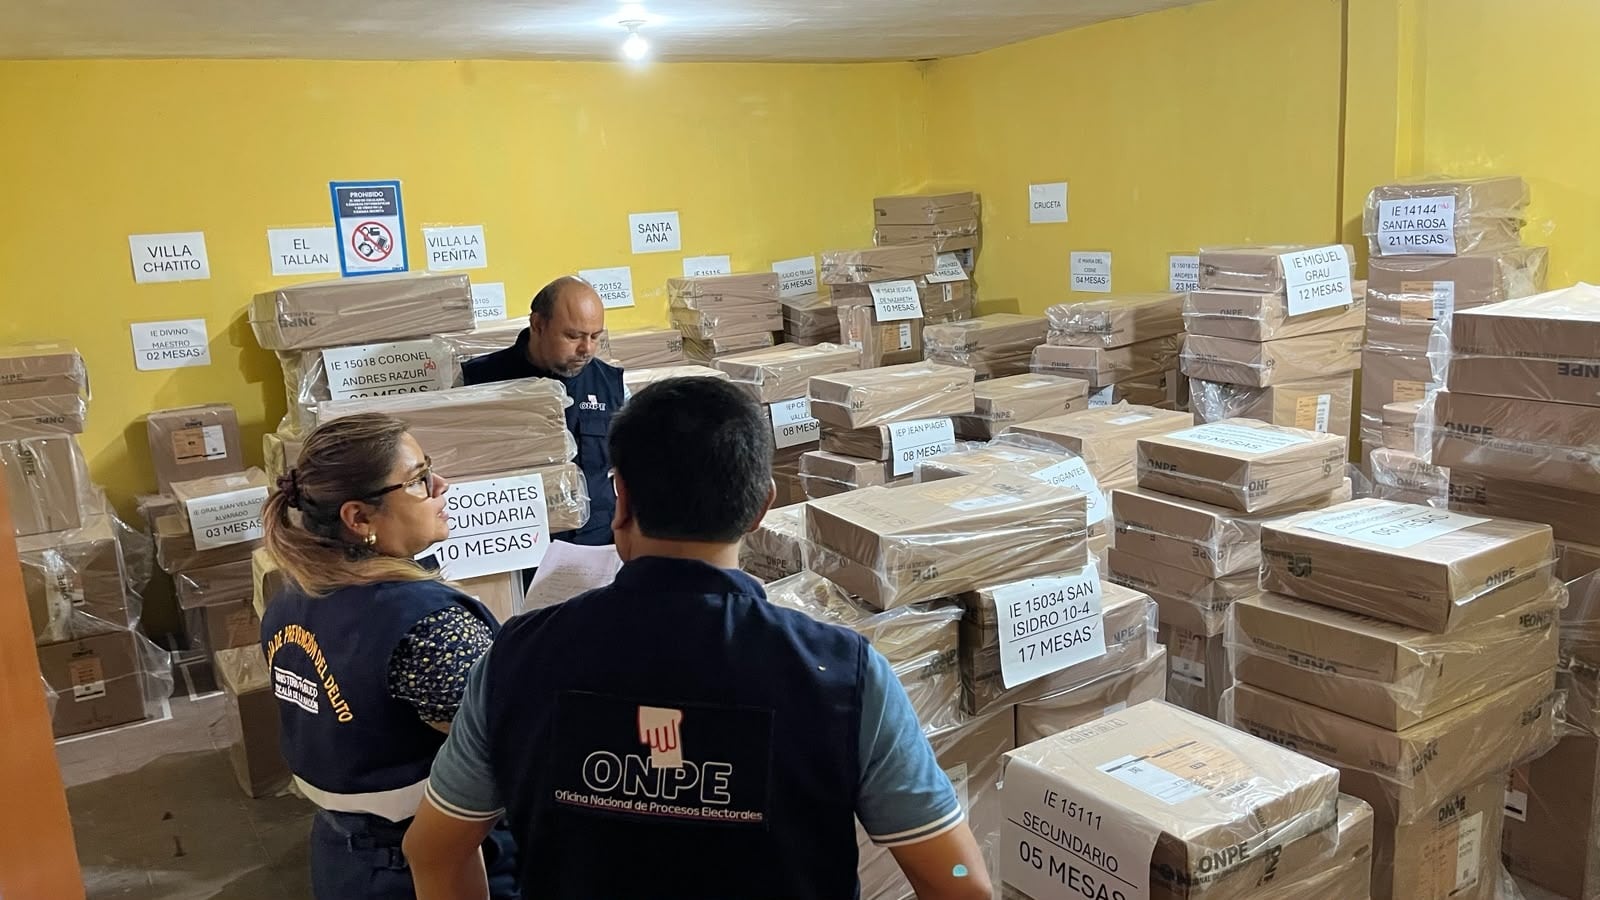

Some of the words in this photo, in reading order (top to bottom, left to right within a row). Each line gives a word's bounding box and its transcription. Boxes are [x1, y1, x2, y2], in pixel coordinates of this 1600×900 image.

[1034, 200, 1061, 209] CRUCETA
[1392, 206, 1400, 216] IE
[1404, 204, 1437, 215] 14144
[638, 222, 672, 234] SANTA
[1382, 219, 1415, 230] SANTA
[1416, 218, 1446, 229] ROSA
[294, 238, 310, 250] EL
[428, 236, 461, 248] VILLA
[464, 234, 478, 246] LA
[646, 233, 668, 244] ANA
[1388, 236, 1400, 246] 21
[1404, 234, 1444, 245] MESAS
[147, 244, 192, 258] VILLA
[433, 248, 477, 262] PEÑITA
[143, 259, 201, 273] CHATITO
[281, 254, 329, 266] TALLAN
[1292, 258, 1302, 268] IE
[1304, 250, 1342, 266] MIGUEL
[1084, 276, 1106, 284] MESAS
[1304, 268, 1330, 282] GRAU
[599, 282, 622, 290] 20152
[790, 278, 812, 288] MESAS
[1176, 282, 1184, 290] 23
[600, 292, 626, 300] MESAS
[1298, 290, 1310, 300] 12
[1312, 282, 1343, 298] MESAS
[892, 304, 915, 312] MESAS
[160, 328, 188, 336] DIVINO
[152, 340, 190, 348] MAESTRO
[146, 352, 160, 361] 02
[162, 348, 200, 359] MESAS
[331, 362, 342, 370] IE
[344, 356, 376, 369] 15018
[378, 352, 431, 365] CORONEL
[342, 373, 387, 386] ANDRES
[389, 369, 427, 380] RAZURI
[1558, 362, 1600, 378] NPE
[580, 402, 606, 410] ONPE
[783, 426, 794, 436] 08
[796, 421, 820, 433] MESA
[896, 428, 906, 437] IEP
[908, 425, 924, 435] JEAN
[925, 420, 948, 430] PIAGET
[904, 450, 914, 462] 08
[916, 444, 943, 459] MESA
[1052, 466, 1086, 485] GIGANTES
[448, 486, 538, 511] SOCRATES
[216, 510, 248, 520] ALVARADO
[448, 506, 536, 531] CUNDARIA
[206, 528, 220, 538] 03
[224, 518, 263, 534] MESAS
[436, 544, 460, 562] 10
[465, 533, 532, 558] MESAS
[1486, 566, 1516, 586] ONPE
[1010, 602, 1022, 619] IE
[1025, 590, 1064, 613] 15034
[1066, 580, 1094, 600] SAN
[1013, 610, 1059, 638] ISIDRO
[1063, 602, 1090, 622] 10-4
[1114, 625, 1135, 642] NPE
[1018, 644, 1036, 663] 17
[1040, 625, 1092, 657] MESAS
[315, 648, 328, 680] DEL
[324, 674, 354, 722] DELITO
[582, 751, 732, 804] ONPE
[555, 790, 588, 804] Oficina
[590, 794, 632, 810] Nacional
[634, 800, 648, 811] de
[650, 802, 700, 816] Procesos
[702, 807, 763, 820] Electorales
[1043, 788, 1057, 810] IE
[1060, 794, 1102, 831] 15111
[1022, 811, 1118, 872] SECUNDARIO
[1020, 840, 1042, 870] 05
[1198, 841, 1250, 874] ONPE
